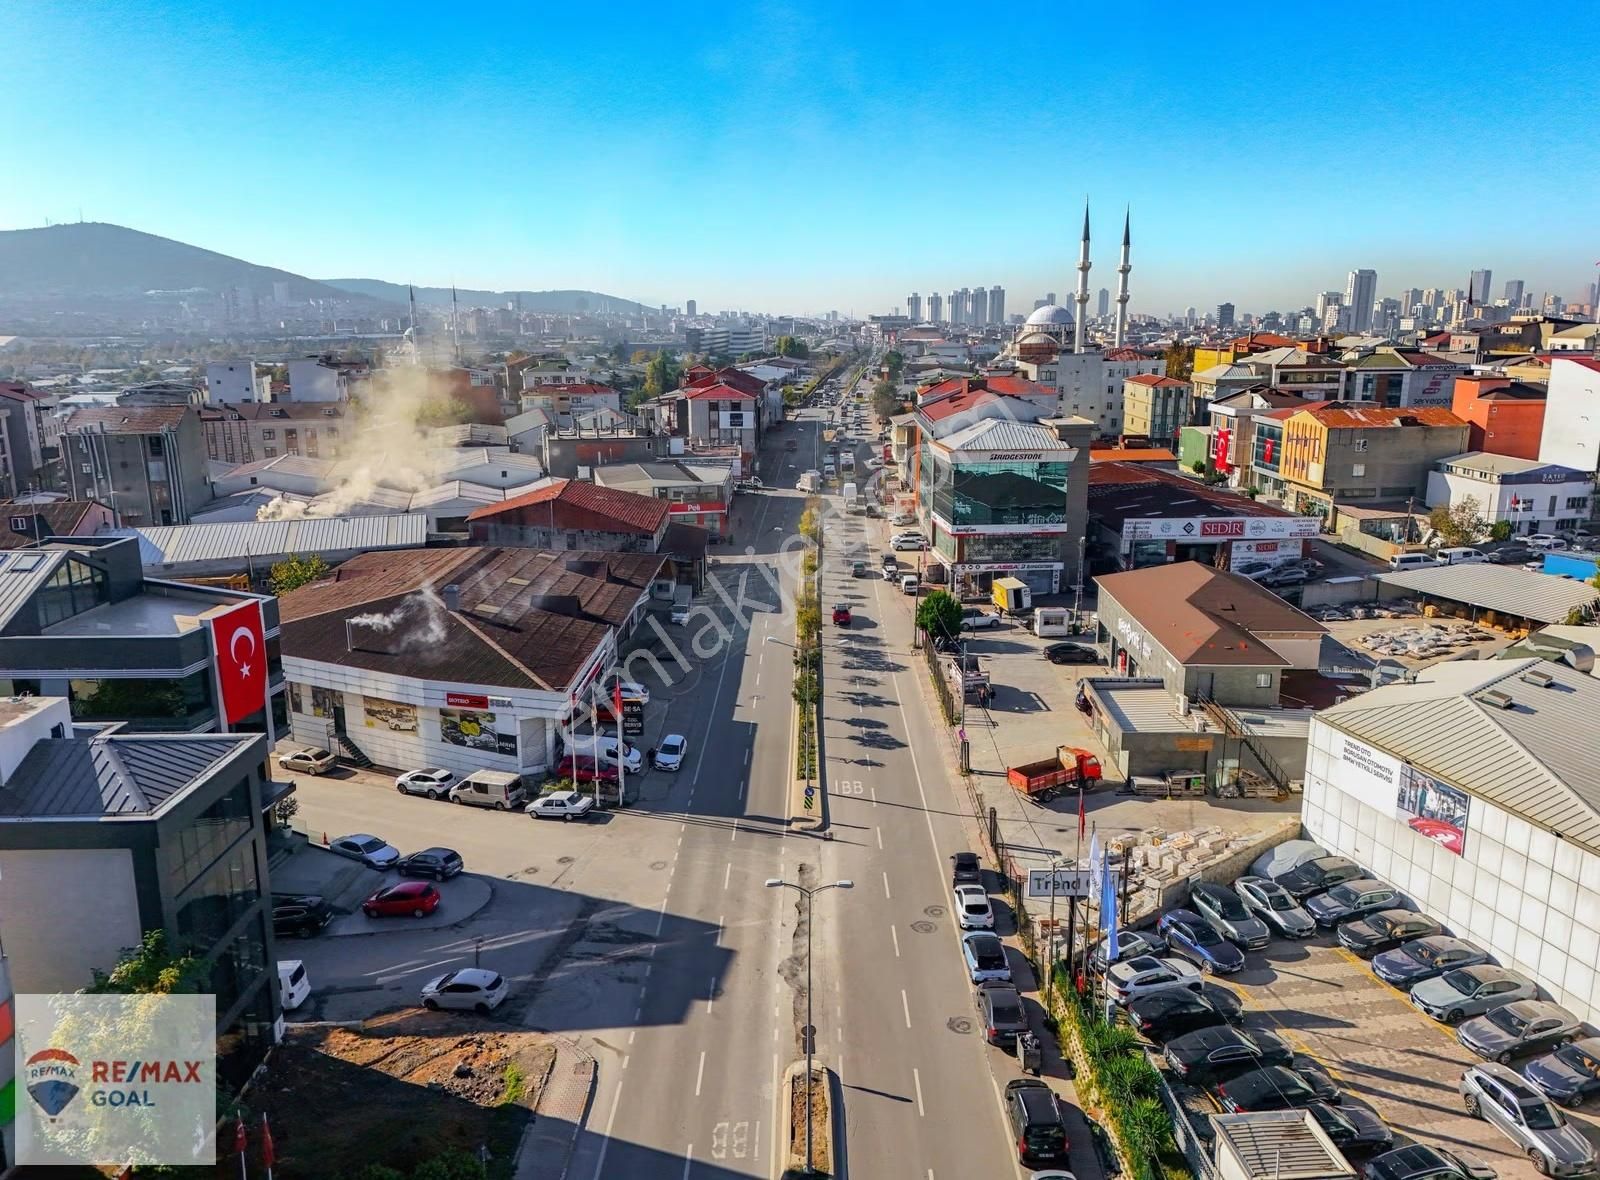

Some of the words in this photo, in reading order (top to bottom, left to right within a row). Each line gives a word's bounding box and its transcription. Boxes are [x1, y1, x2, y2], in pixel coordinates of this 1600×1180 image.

[1345, 740, 1361, 752] TREND
[1361, 747, 1371, 757] OTO
[1034, 877, 1081, 890] Trend
